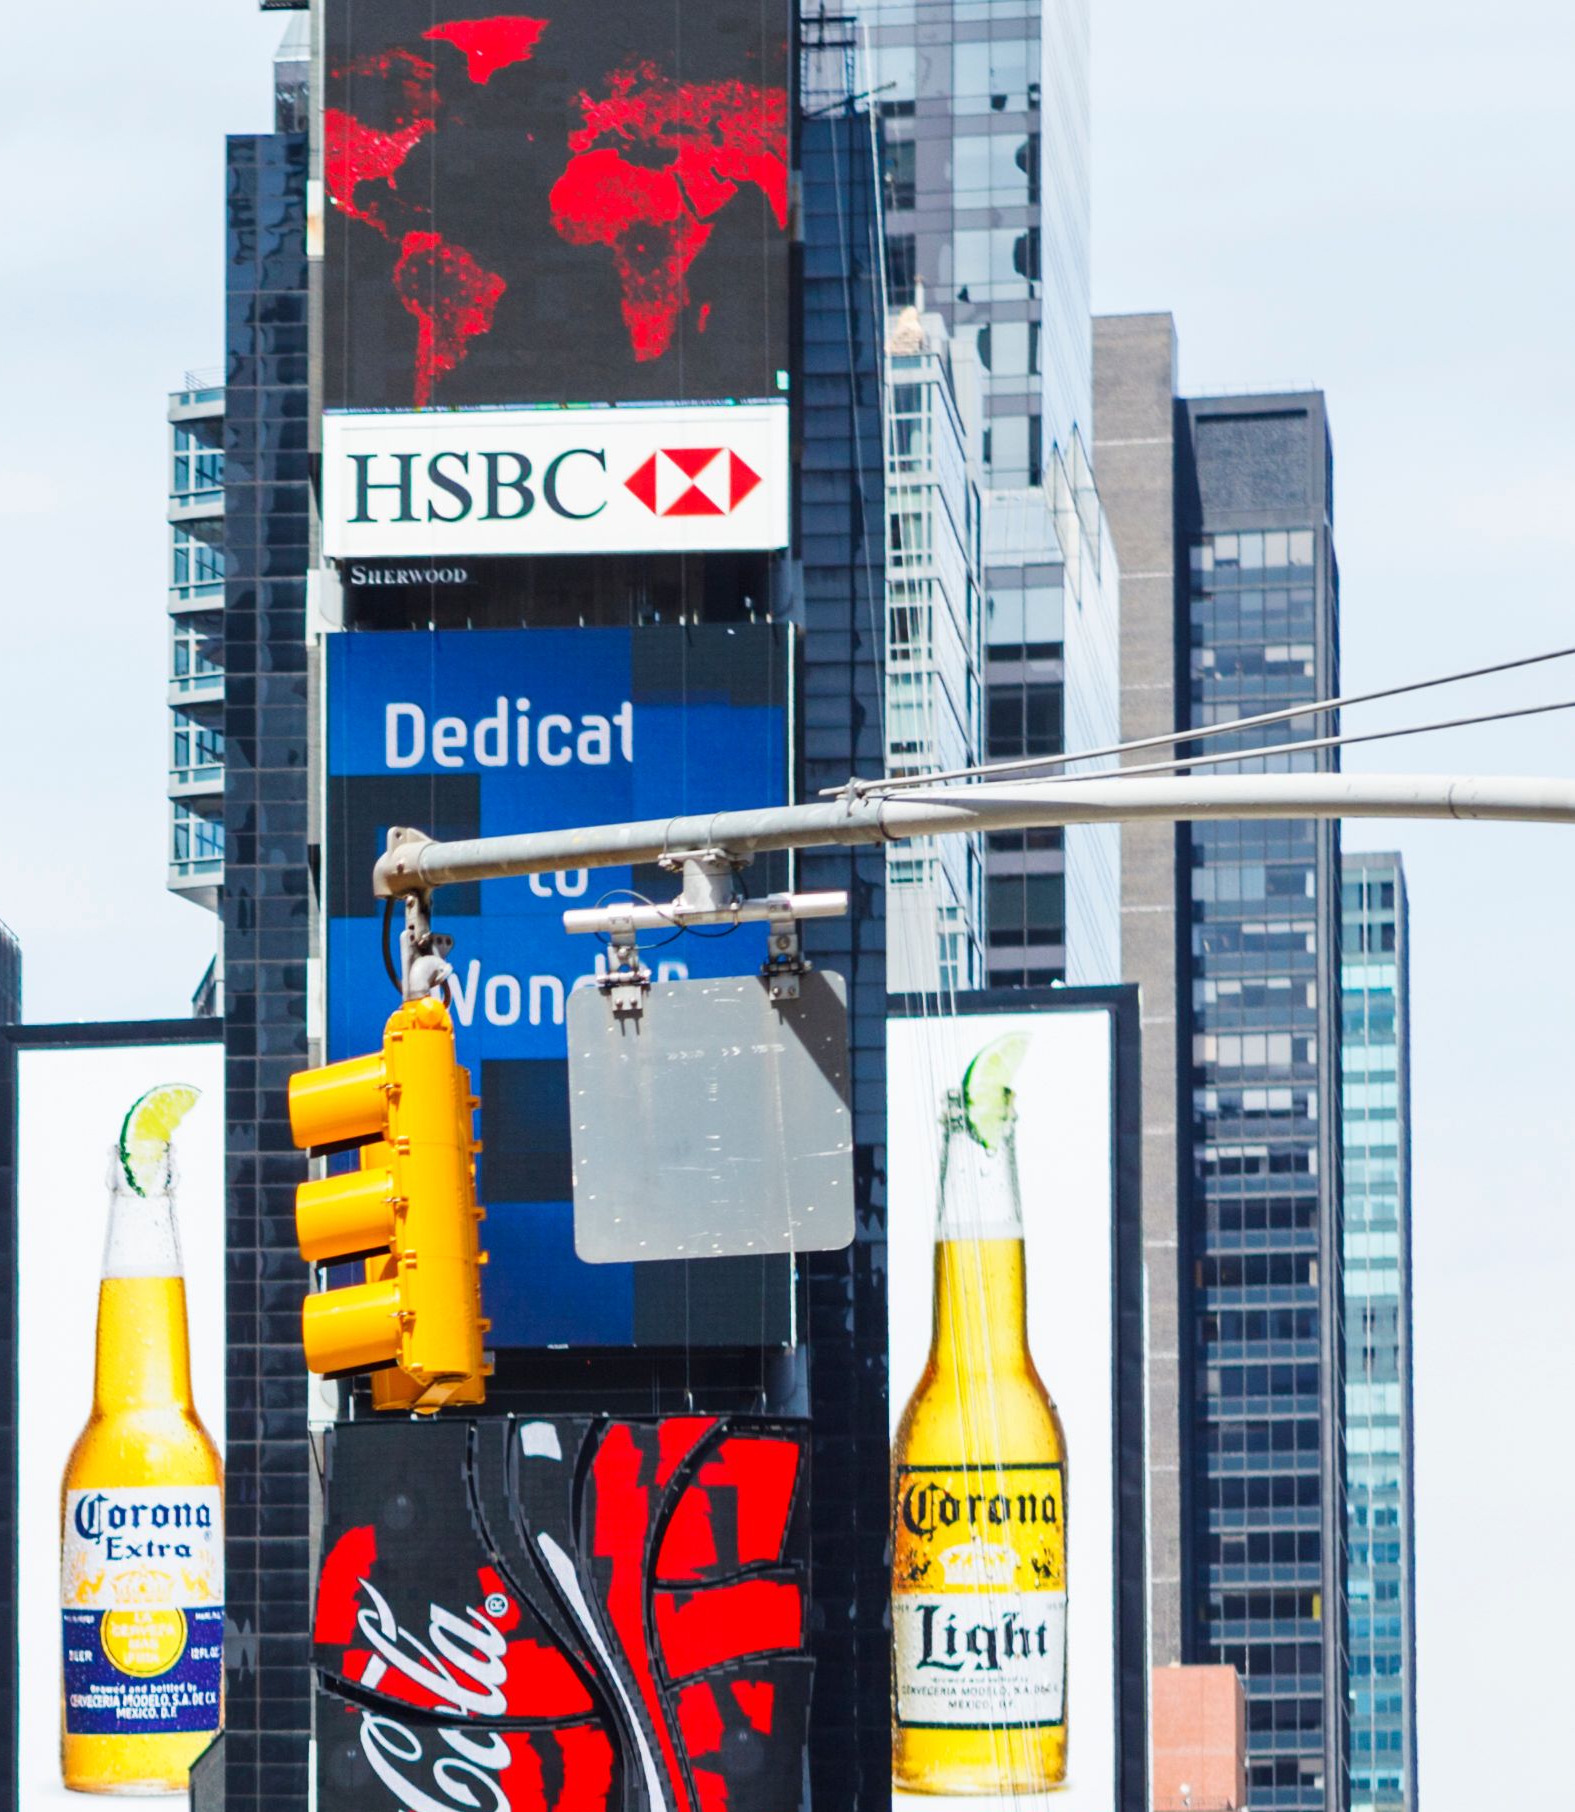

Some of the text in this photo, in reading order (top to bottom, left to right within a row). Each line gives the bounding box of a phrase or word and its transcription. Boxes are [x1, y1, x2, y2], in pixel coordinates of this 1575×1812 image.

[346, 447, 608, 523] HSBC
[350, 564, 468, 586] SHERWOOD
[383, 696, 634, 769] Dedicat
[74, 1493, 212, 1545] Corona
[902, 1480, 1058, 1542] Corona
[106, 1535, 192, 1562] Extra
[915, 1603, 1048, 1672] Light
